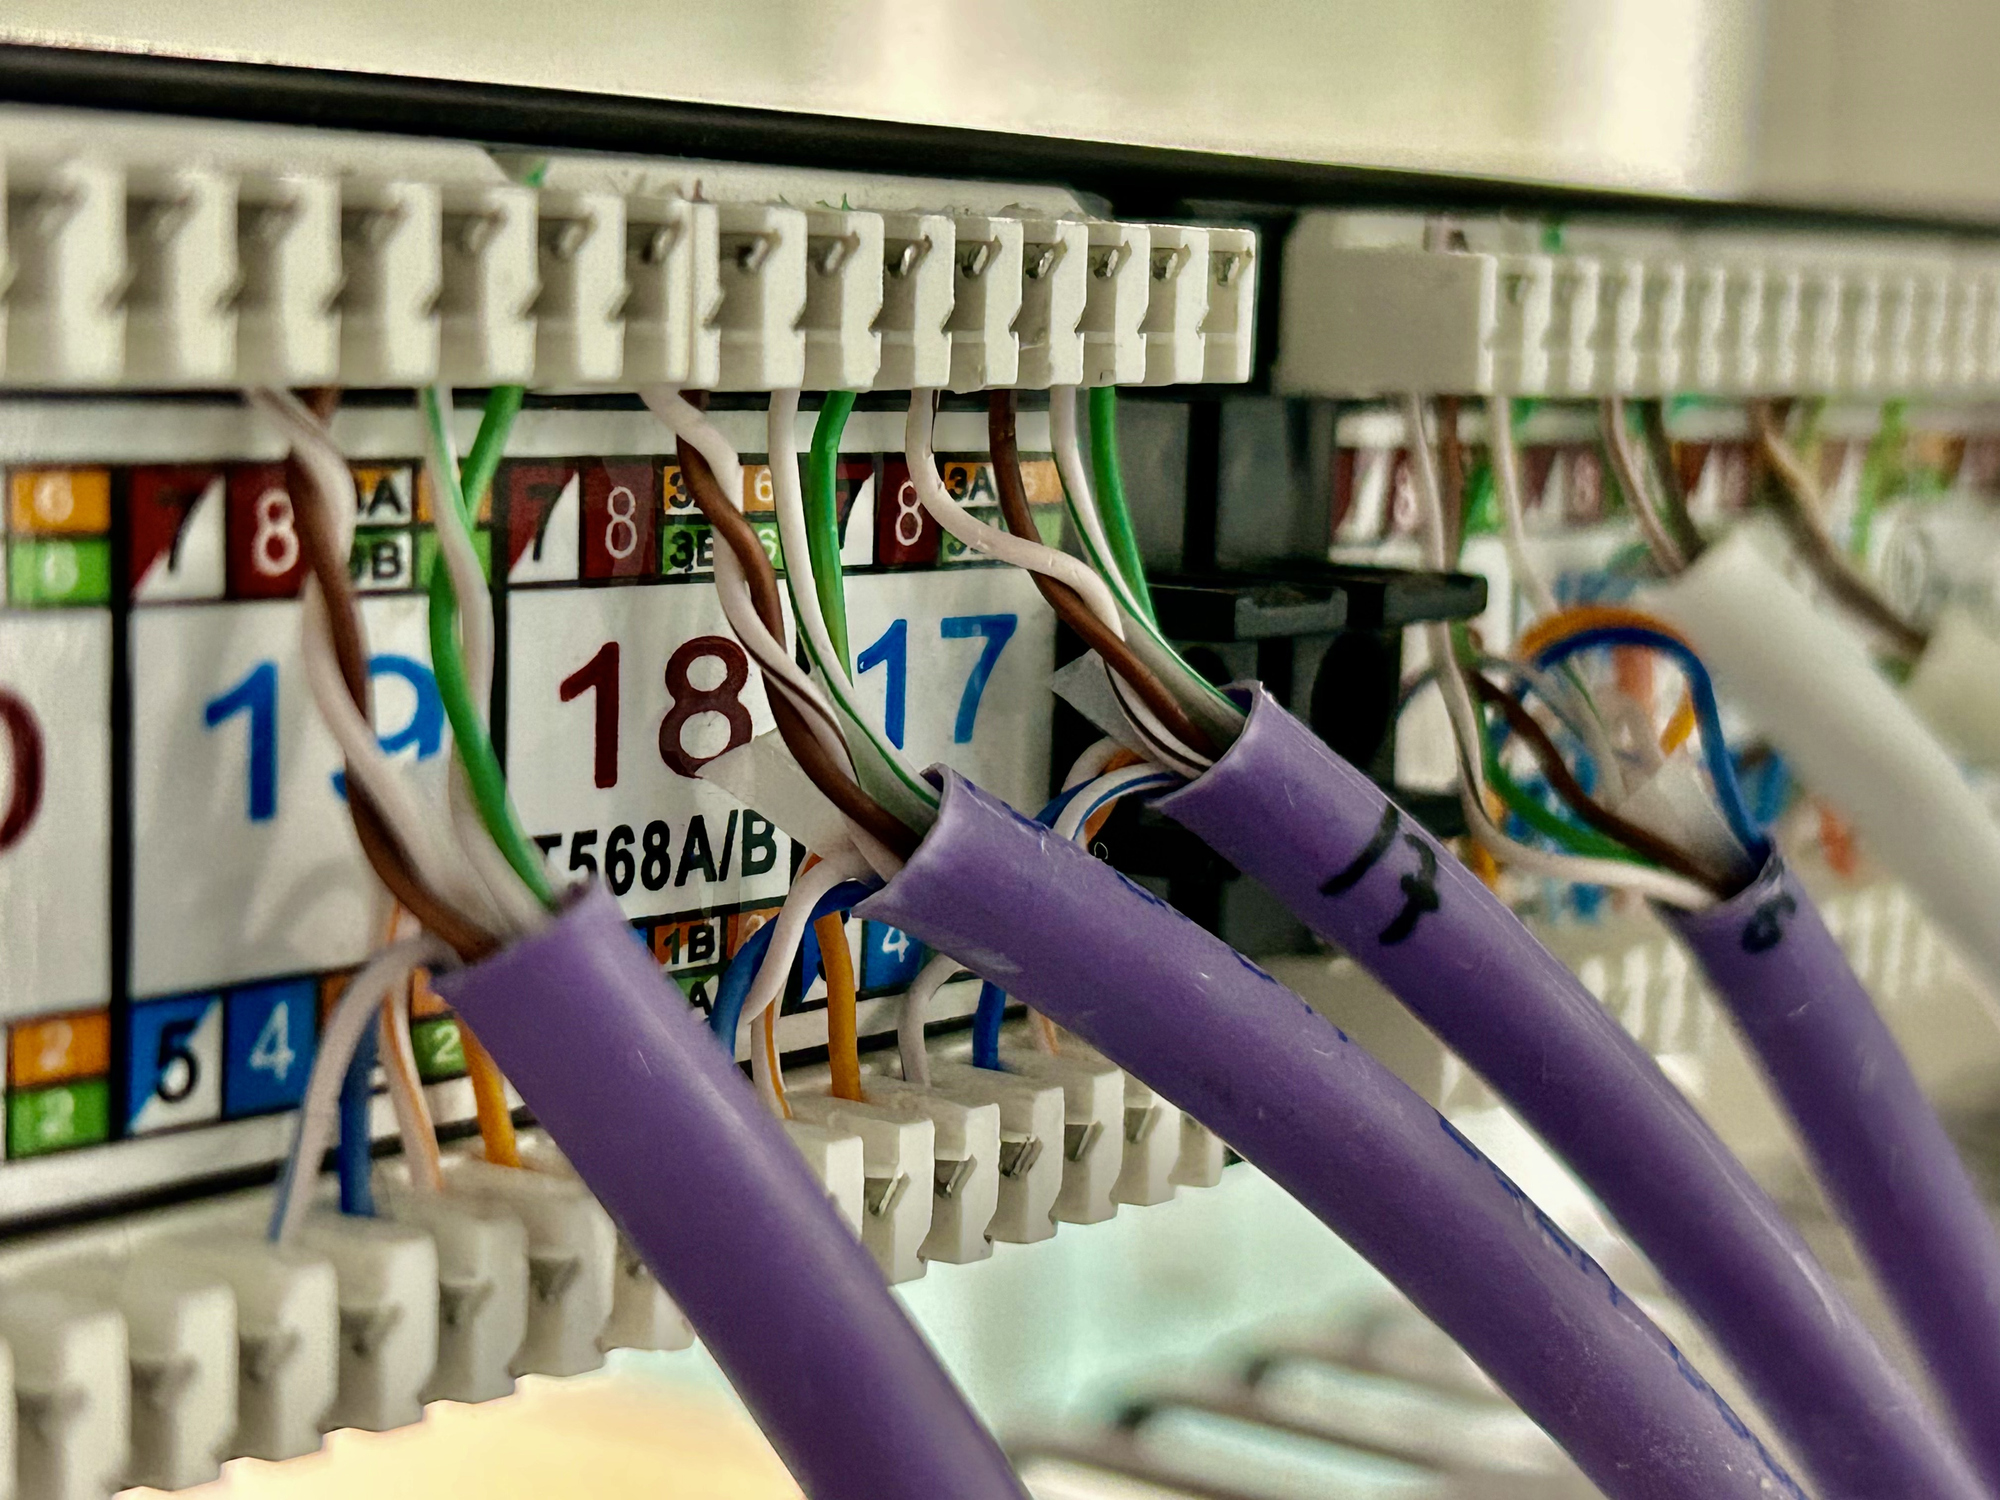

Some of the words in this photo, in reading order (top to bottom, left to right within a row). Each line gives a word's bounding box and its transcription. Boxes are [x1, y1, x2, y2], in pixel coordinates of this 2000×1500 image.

[525, 481, 565, 562] 7
[605, 486, 638, 559] 8
[755, 468, 774, 501] 6
[895, 480, 923, 546] 8
[946, 466, 996, 502] 3A
[253, 488, 300, 577] 8
[560, 635, 753, 789] 18
[857, 614, 1018, 750] 17
[205, 654, 445, 822] 19
[531, 808, 777, 897] 568A/B
[1319, 799, 1439, 946] 17
[663, 924, 715, 965] 1B
[882, 926, 910, 963] 4
[156, 1017, 201, 1103] 5
[250, 1000, 296, 1082] 4
[431, 1024, 460, 1064] 2
